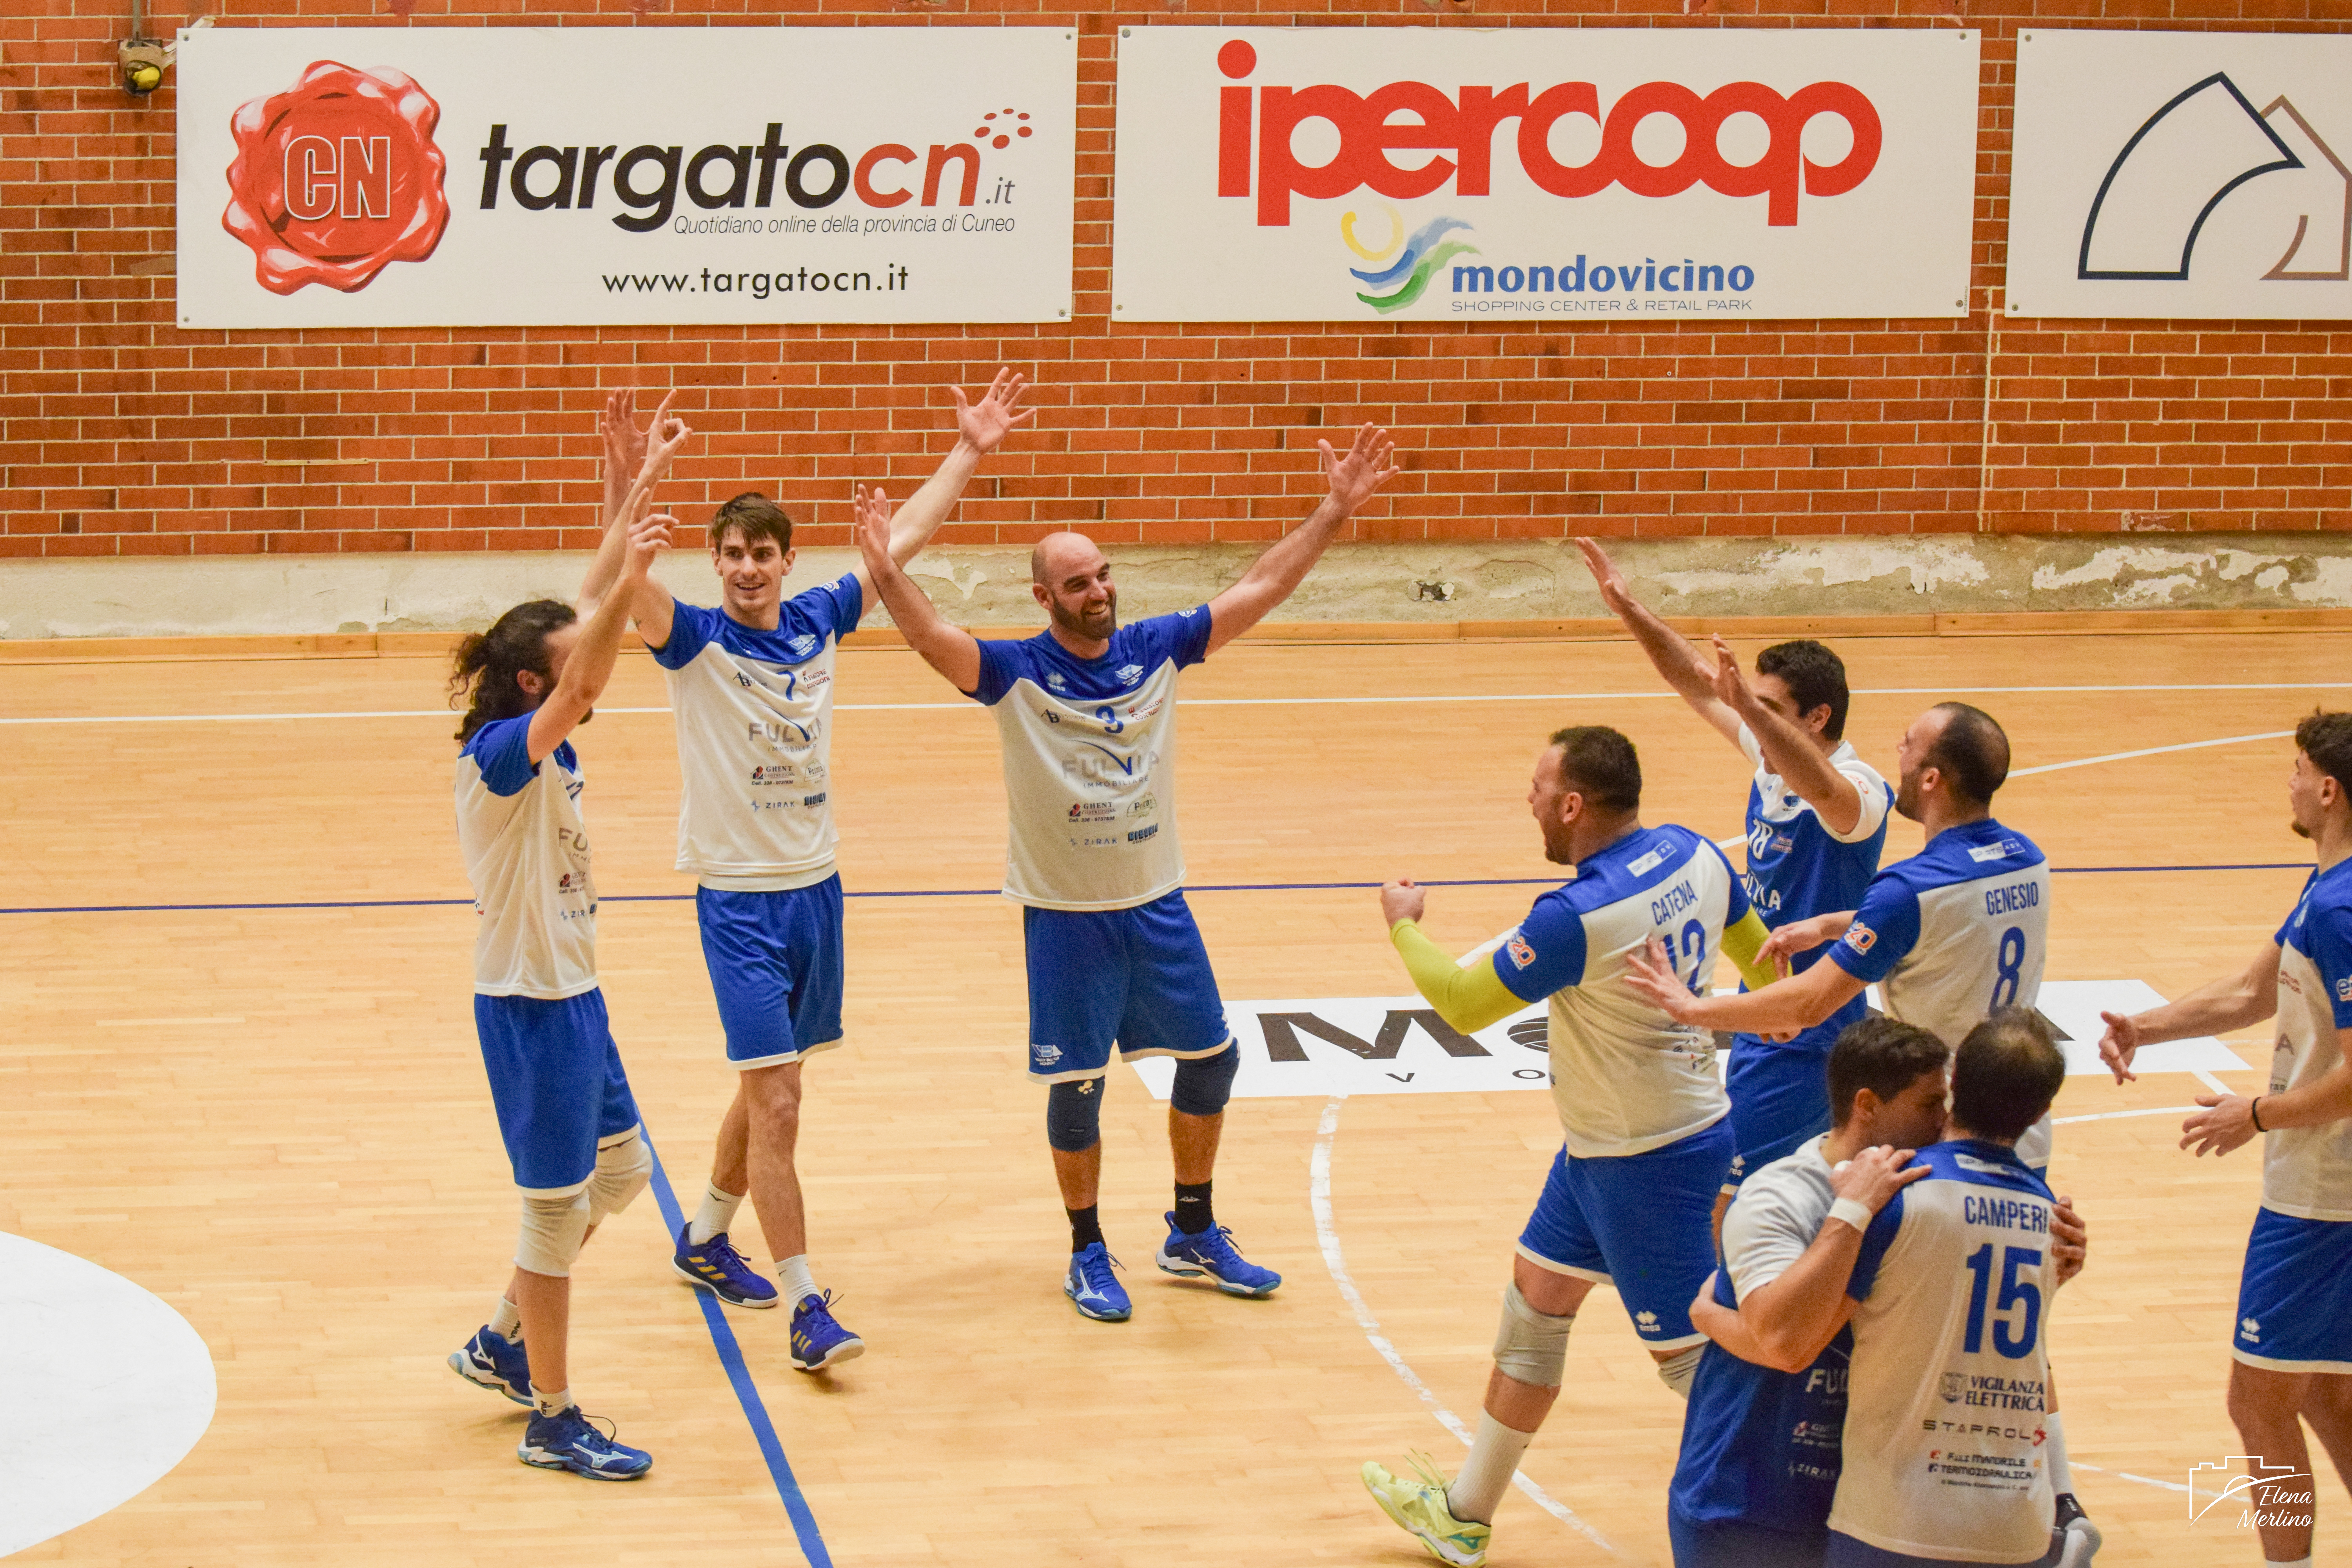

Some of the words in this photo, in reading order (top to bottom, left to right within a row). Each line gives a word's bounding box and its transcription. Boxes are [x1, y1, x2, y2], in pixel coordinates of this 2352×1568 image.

[1218, 40, 1882, 227] ipercoop
[285, 135, 390, 220] CN
[675, 216, 763, 235] Quotidiano
[769, 215, 817, 234] online
[822, 215, 859, 234] della
[864, 214, 936, 236] provincia
[942, 214, 958, 232] di
[962, 214, 1015, 232] Cuneo
[602, 263, 909, 300] www.targatocn.it
[1452, 301, 1545, 312] SHOPPING
[1550, 301, 1621, 312] CENTER
[1626, 299, 1638, 311] &
[1645, 300, 1702, 311] RETAIL
[1707, 300, 1752, 311] PARK
[1096, 705, 1124, 734] 3
[1083, 775, 1149, 788] IMMOBILIARE
[1651, 880, 1699, 926] CATENA
[1985, 881, 2039, 916] GENESIO
[1988, 926, 2025, 1019] 8
[1964, 1196, 2048, 1234] CAMPERI
[1964, 1243, 2042, 1359] 15
[1965, 1390, 2045, 1412] ELETTRICA
[1971, 1375, 2044, 1395] VIGILANZA
